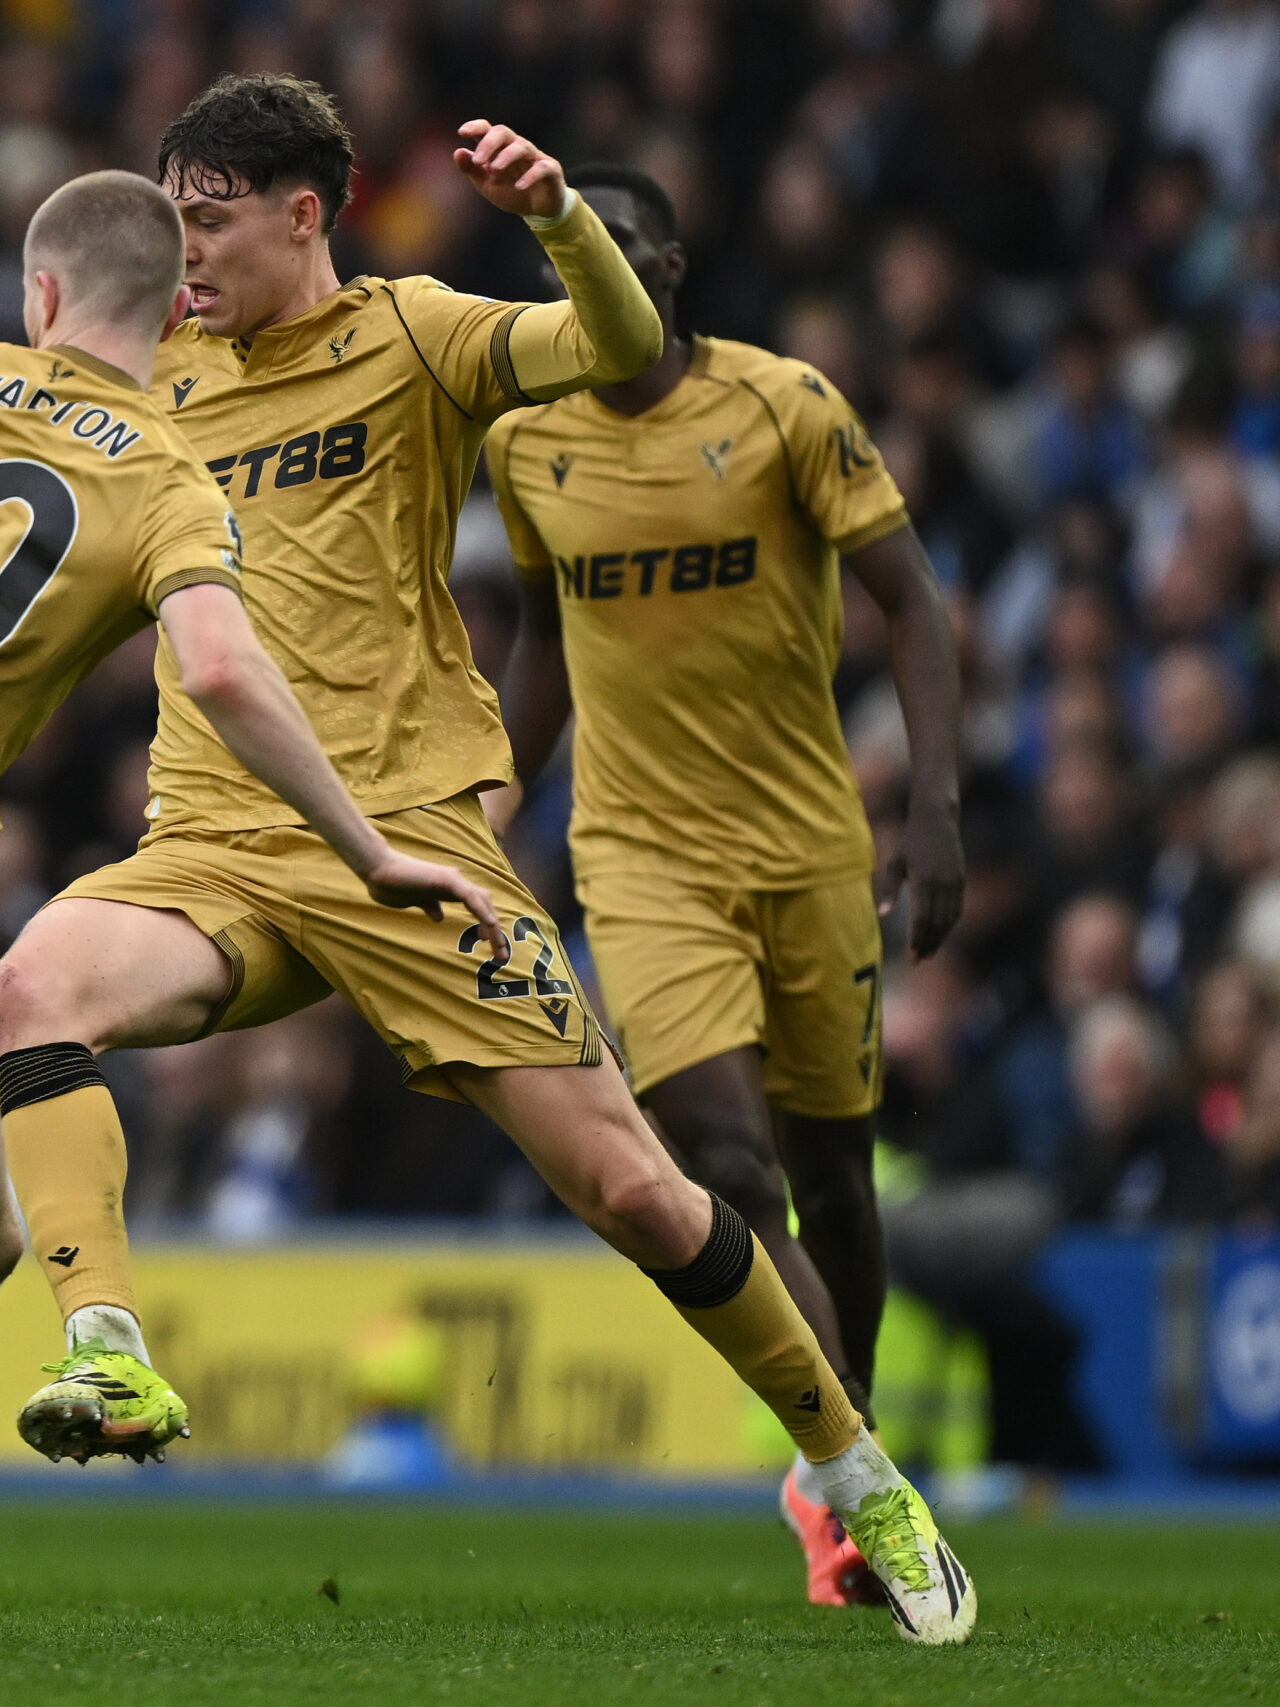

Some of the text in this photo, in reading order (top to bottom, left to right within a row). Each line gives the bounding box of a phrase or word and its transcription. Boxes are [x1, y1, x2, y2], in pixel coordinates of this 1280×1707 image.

[558, 535, 757, 601] NET88
[457, 915, 575, 1000] 22
[853, 963, 878, 1045] 7
